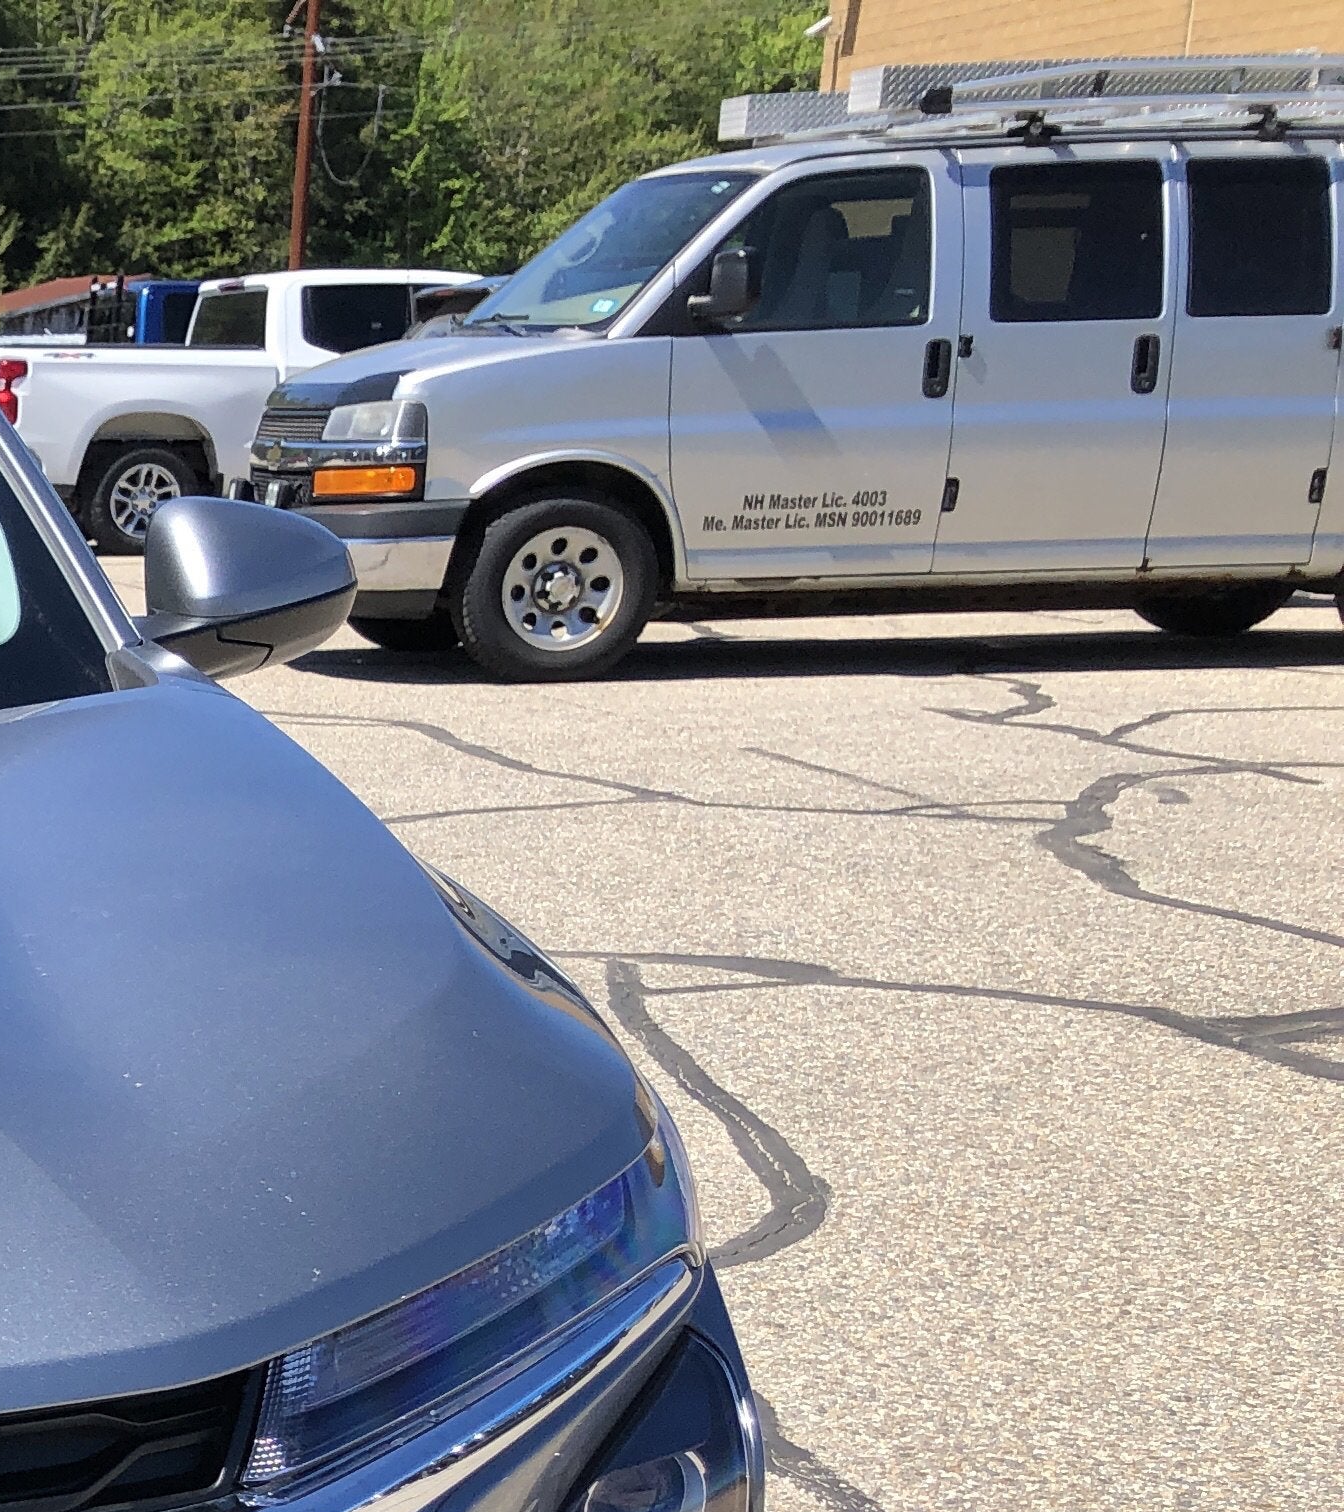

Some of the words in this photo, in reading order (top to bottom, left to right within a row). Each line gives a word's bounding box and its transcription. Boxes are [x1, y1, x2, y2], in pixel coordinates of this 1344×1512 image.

[743, 494, 765, 510] NH
[768, 493, 818, 509] Master
[821, 491, 847, 507] Lic.
[851, 490, 888, 506] 4003
[702, 515, 726, 531] Me.
[731, 514, 781, 530] Master
[784, 513, 810, 528] Lic.
[814, 511, 848, 527] MSN
